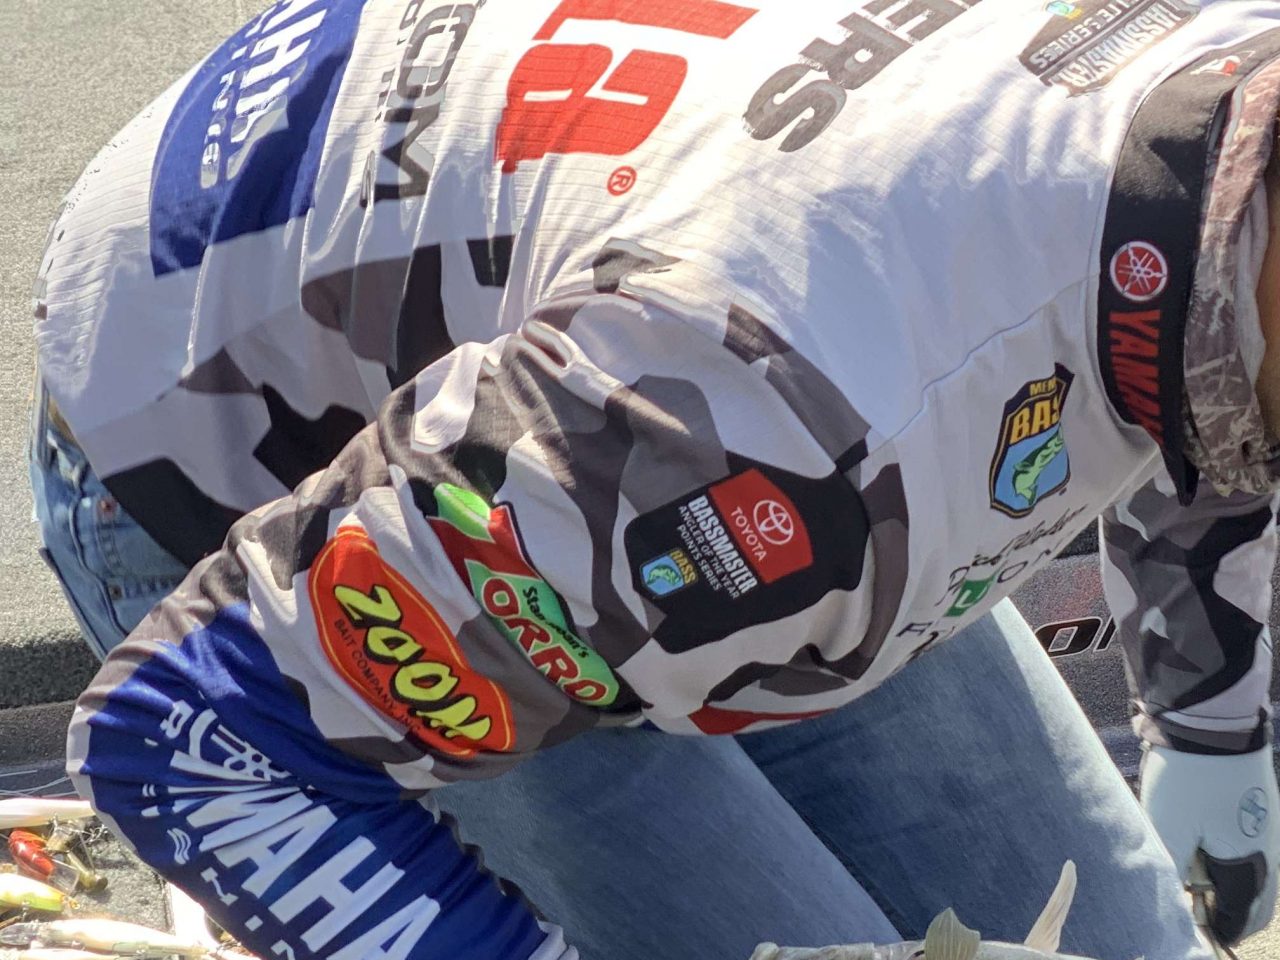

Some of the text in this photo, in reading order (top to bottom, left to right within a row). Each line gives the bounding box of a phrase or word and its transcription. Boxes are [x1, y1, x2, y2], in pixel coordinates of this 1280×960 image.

[676, 523, 723, 591] POINTS SERIES
[678, 505, 740, 600] ANGLER OF THE YEAR
[688, 495, 758, 594] BASSMASTER
[731, 506, 768, 562] TOYOTA
[332, 583, 493, 742] ZOOM
[334, 618, 357, 648] BAIT
